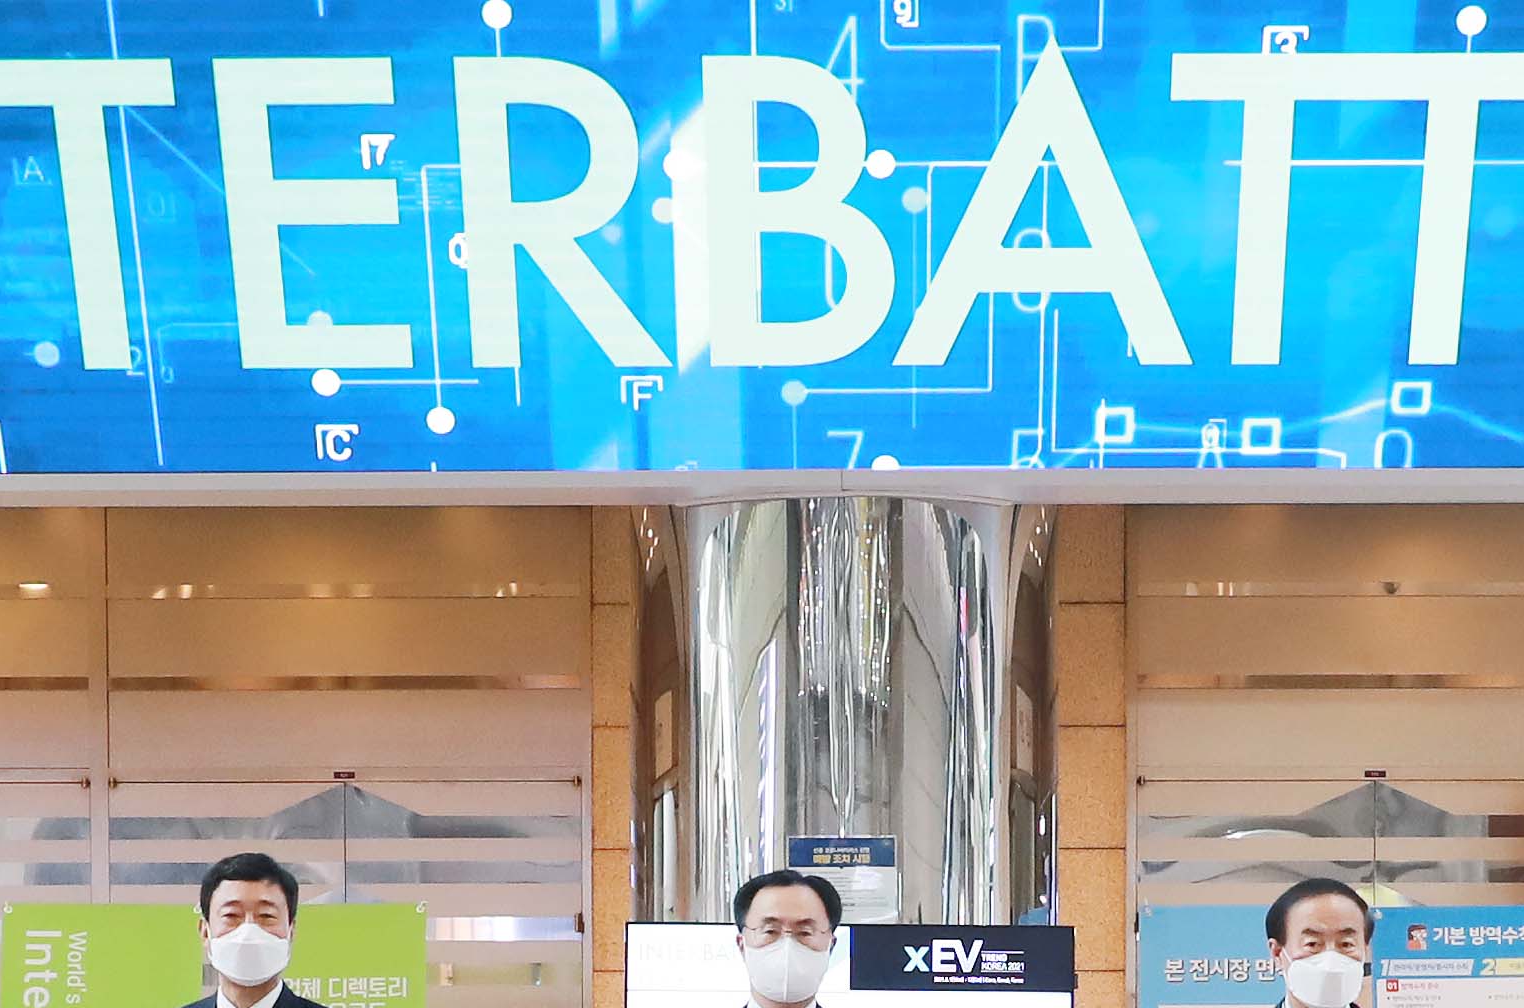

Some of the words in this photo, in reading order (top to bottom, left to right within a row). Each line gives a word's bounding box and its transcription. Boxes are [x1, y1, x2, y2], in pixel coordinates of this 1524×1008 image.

[1433, 926, 1467, 945] 기본
[65, 932, 89, 1005] World's
[903, 939, 984, 973] xEV
[1165, 958, 1186, 983] 본
[1189, 958, 1251, 983] 전시장
[329, 976, 408, 999] 디렉토리
